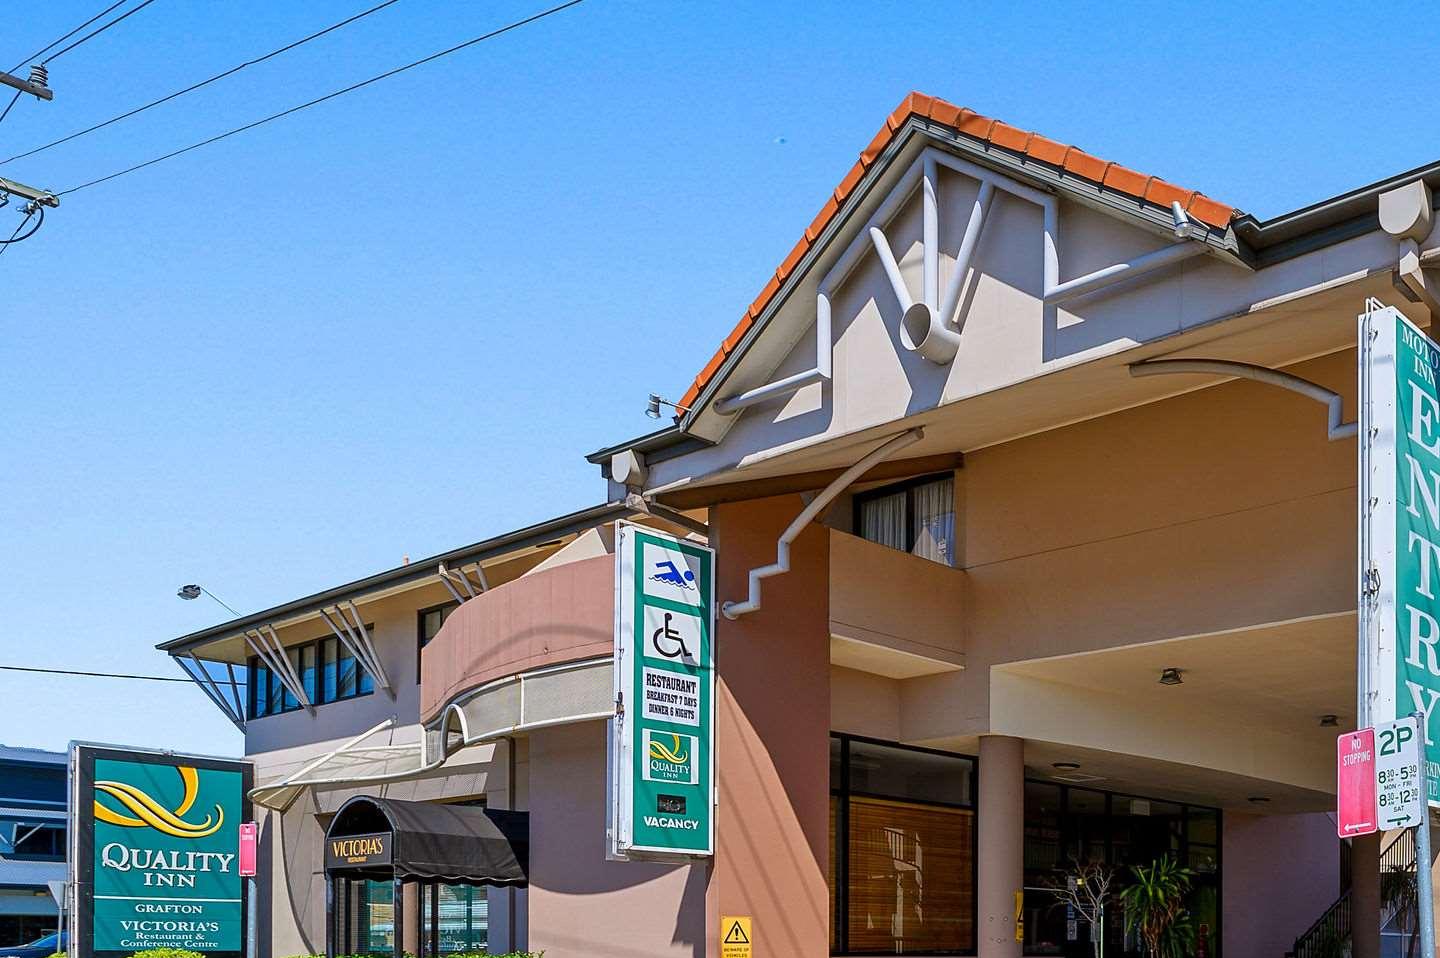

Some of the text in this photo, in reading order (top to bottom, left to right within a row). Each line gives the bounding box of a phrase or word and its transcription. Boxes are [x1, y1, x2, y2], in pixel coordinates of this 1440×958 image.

[1414, 355, 1437, 391] INN
[646, 673, 697, 695] RESTAURANT
[646, 690, 678, 704] BREAKFAST
[684, 697, 698, 708] DAYS
[648, 703, 669, 716] DINNER
[675, 708, 695, 720] NIGHTS
[1351, 738, 1361, 750] NO
[1379, 726, 1413, 756] 2P
[1343, 750, 1371, 766] STOPPING
[651, 760, 690, 774] QUALITY
[643, 815, 699, 830] VACANCY
[333, 837, 383, 857] VICTORIA'S
[102, 843, 235, 873] QUALITY
[143, 872, 196, 888] INN
[135, 904, 203, 914] GRAFTON
[120, 920, 219, 932] VICTORIA'S
[120, 940, 219, 948] Conference Centre
[136, 932, 205, 941] Restaurant &
